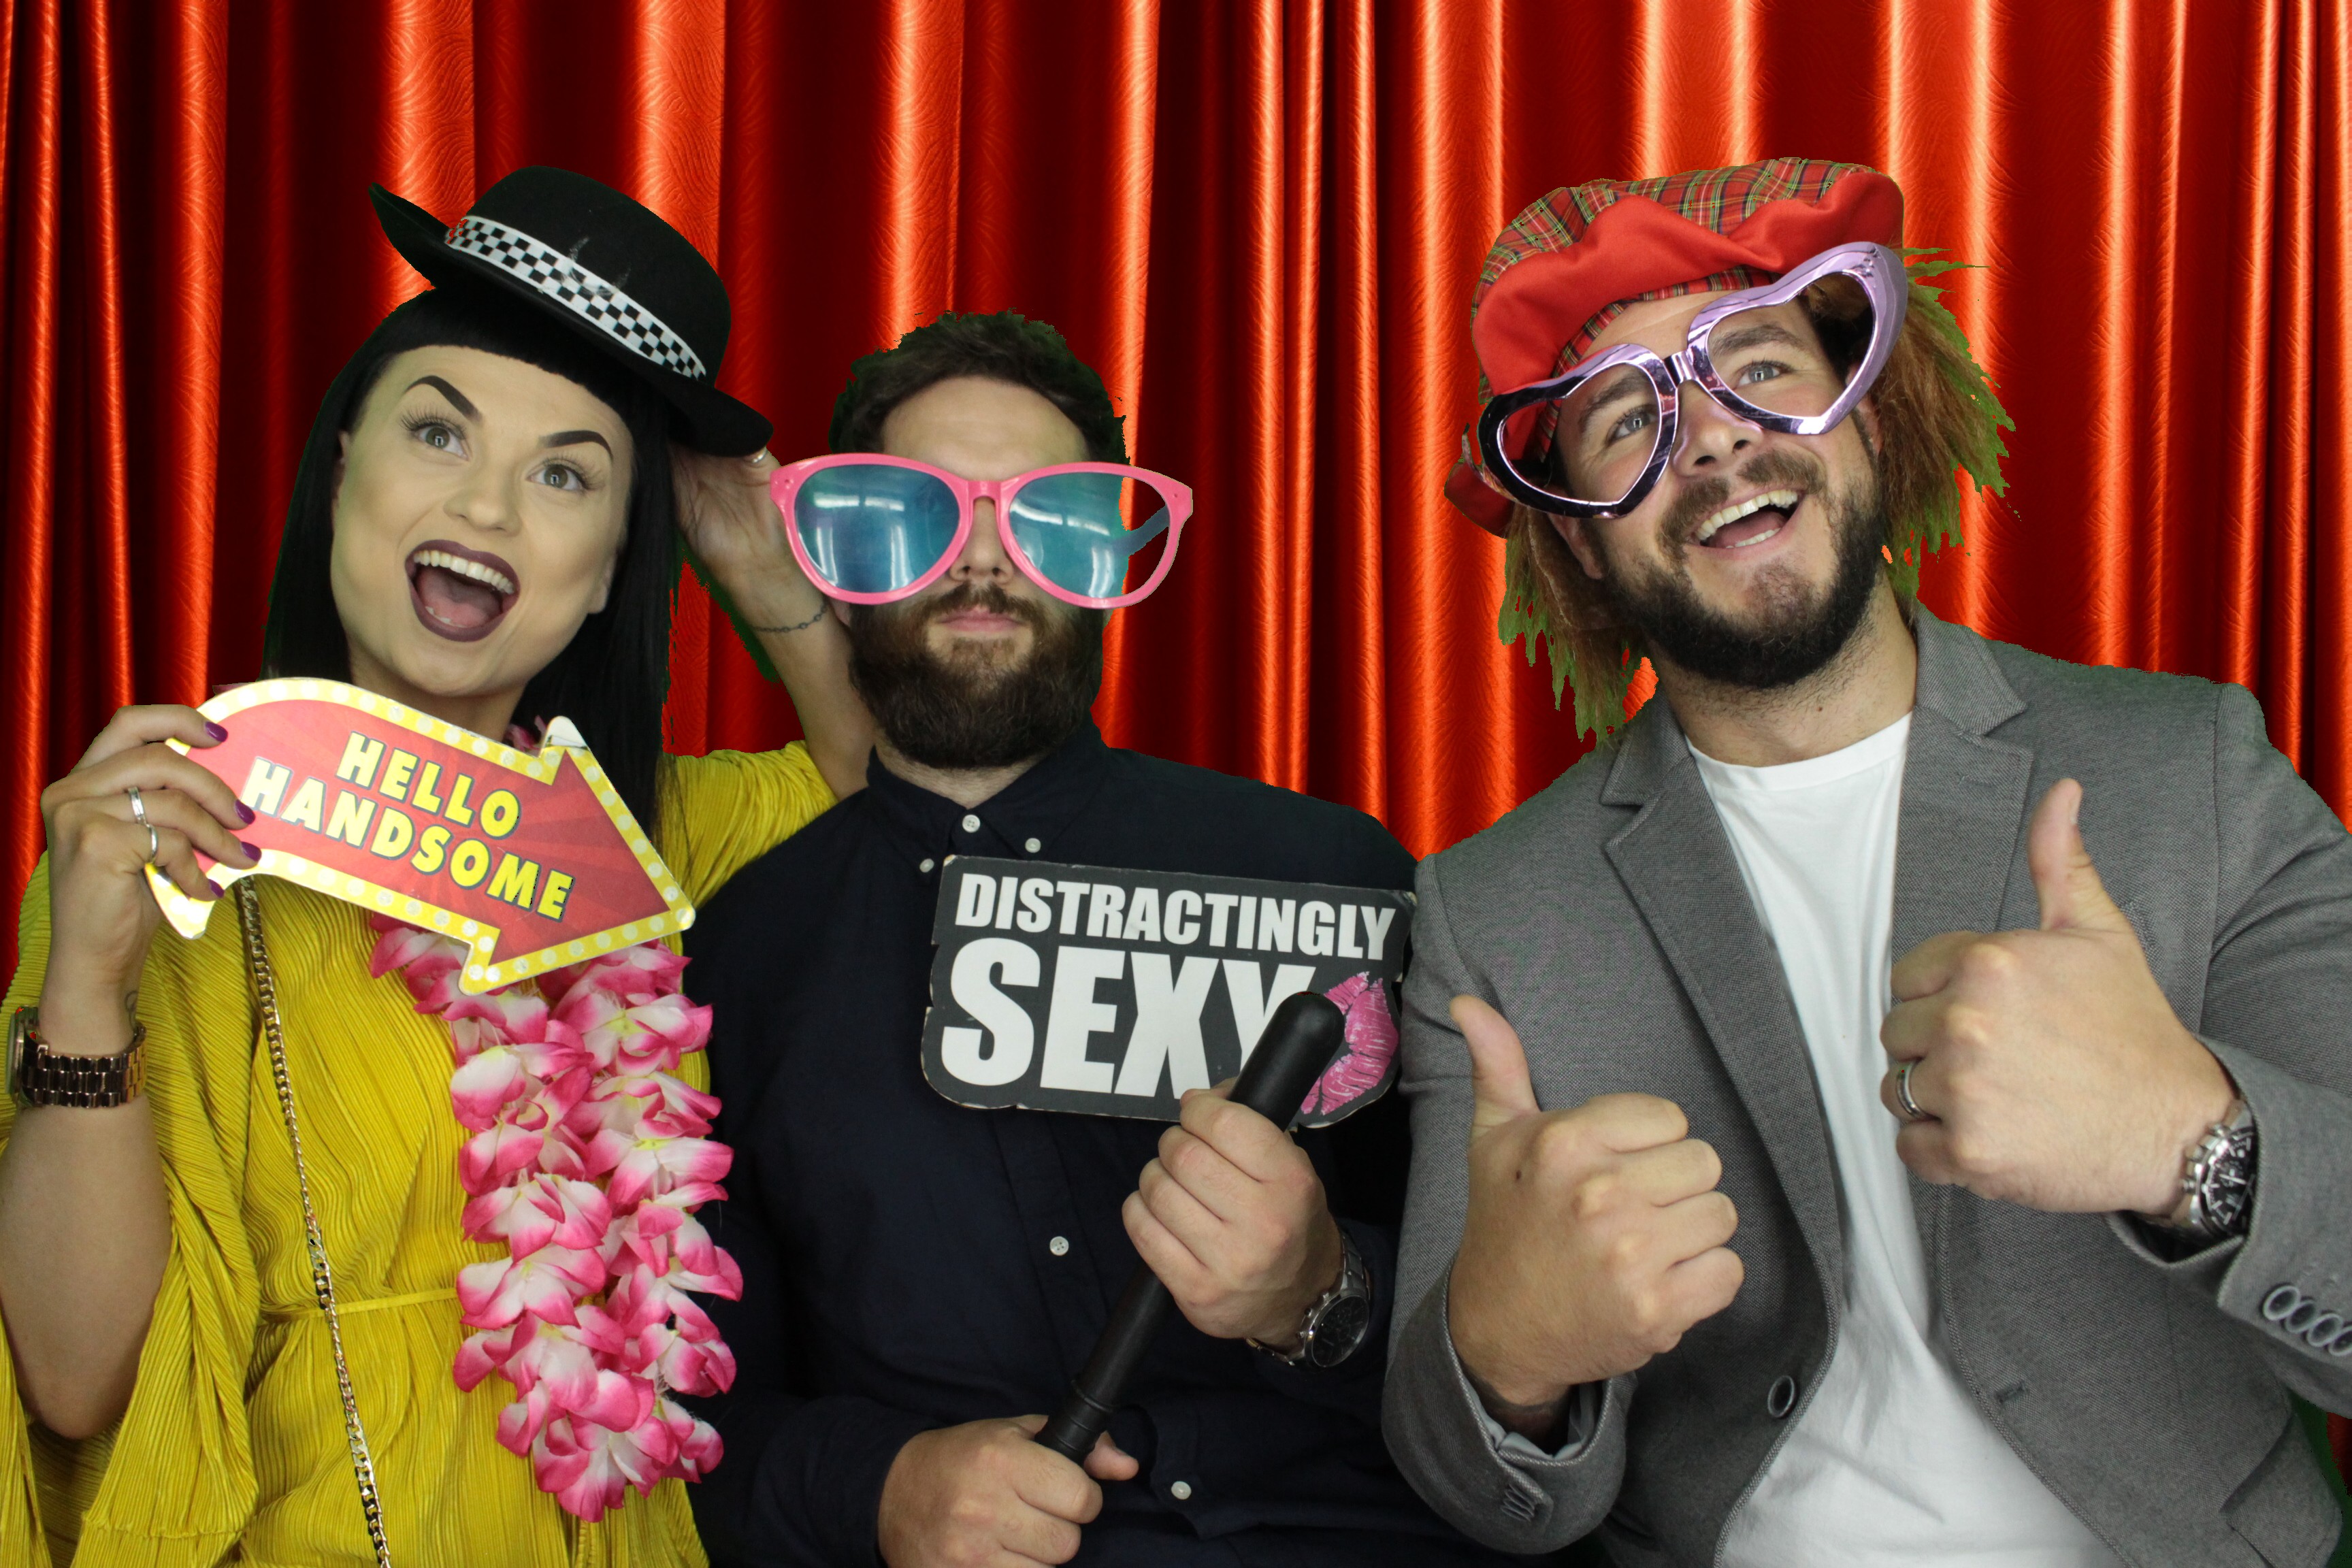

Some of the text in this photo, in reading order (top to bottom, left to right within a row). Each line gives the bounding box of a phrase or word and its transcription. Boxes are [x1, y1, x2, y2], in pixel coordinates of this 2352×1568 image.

[238, 757, 575, 921] HANDSOME
[336, 730, 521, 840] HELLO
[955, 873, 1396, 961] DISTRACTINGLY
[941, 937, 1316, 1100] SEXY
